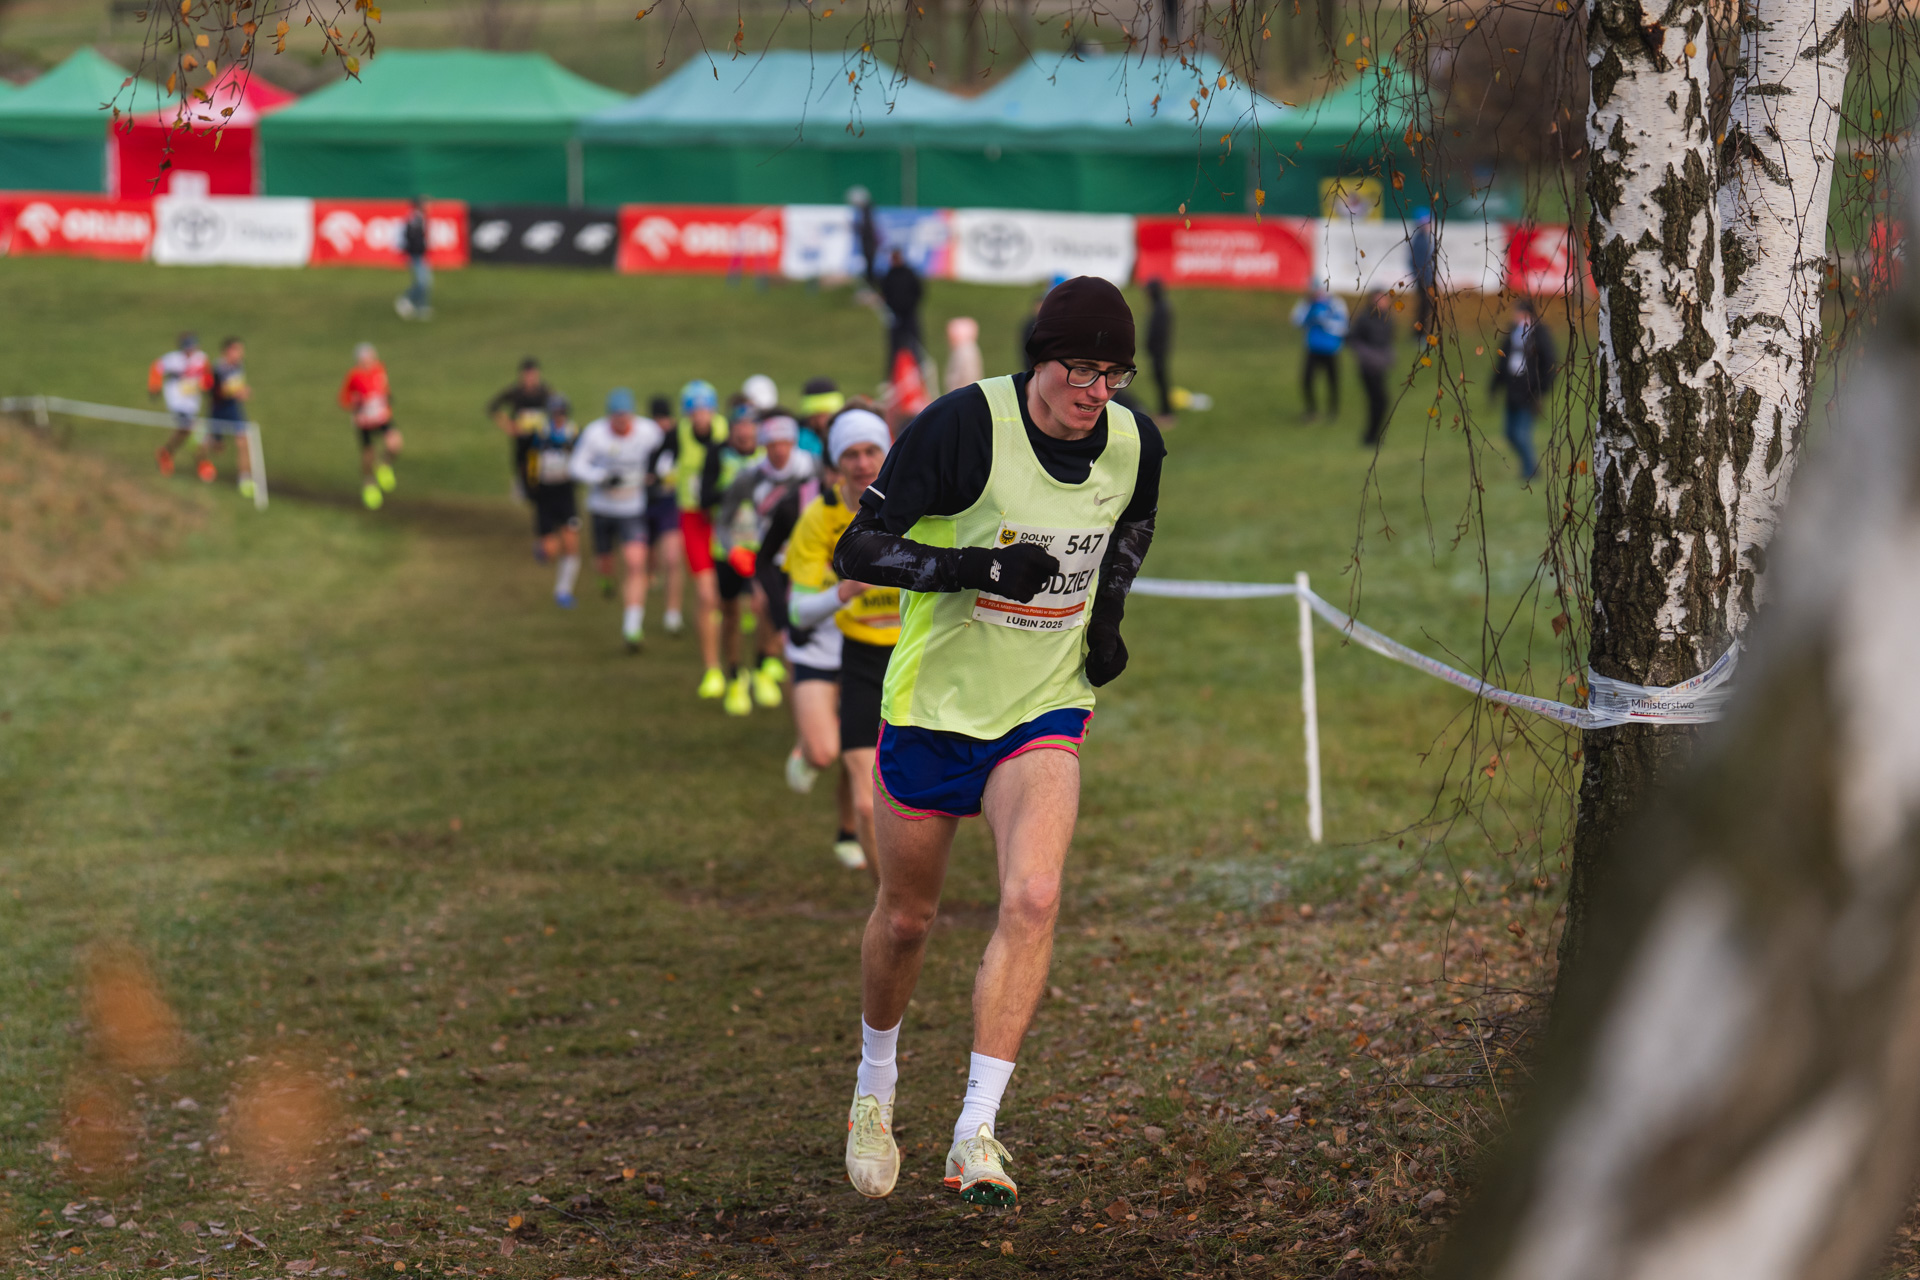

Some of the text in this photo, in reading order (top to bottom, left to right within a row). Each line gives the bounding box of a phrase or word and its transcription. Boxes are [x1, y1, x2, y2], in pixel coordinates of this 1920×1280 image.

[1021, 532, 1055, 543] DOLNY
[1064, 533, 1104, 555] 547
[1006, 616, 1063, 629] LUBIN 2025
[1631, 698, 1695, 710] Ministerstwo
